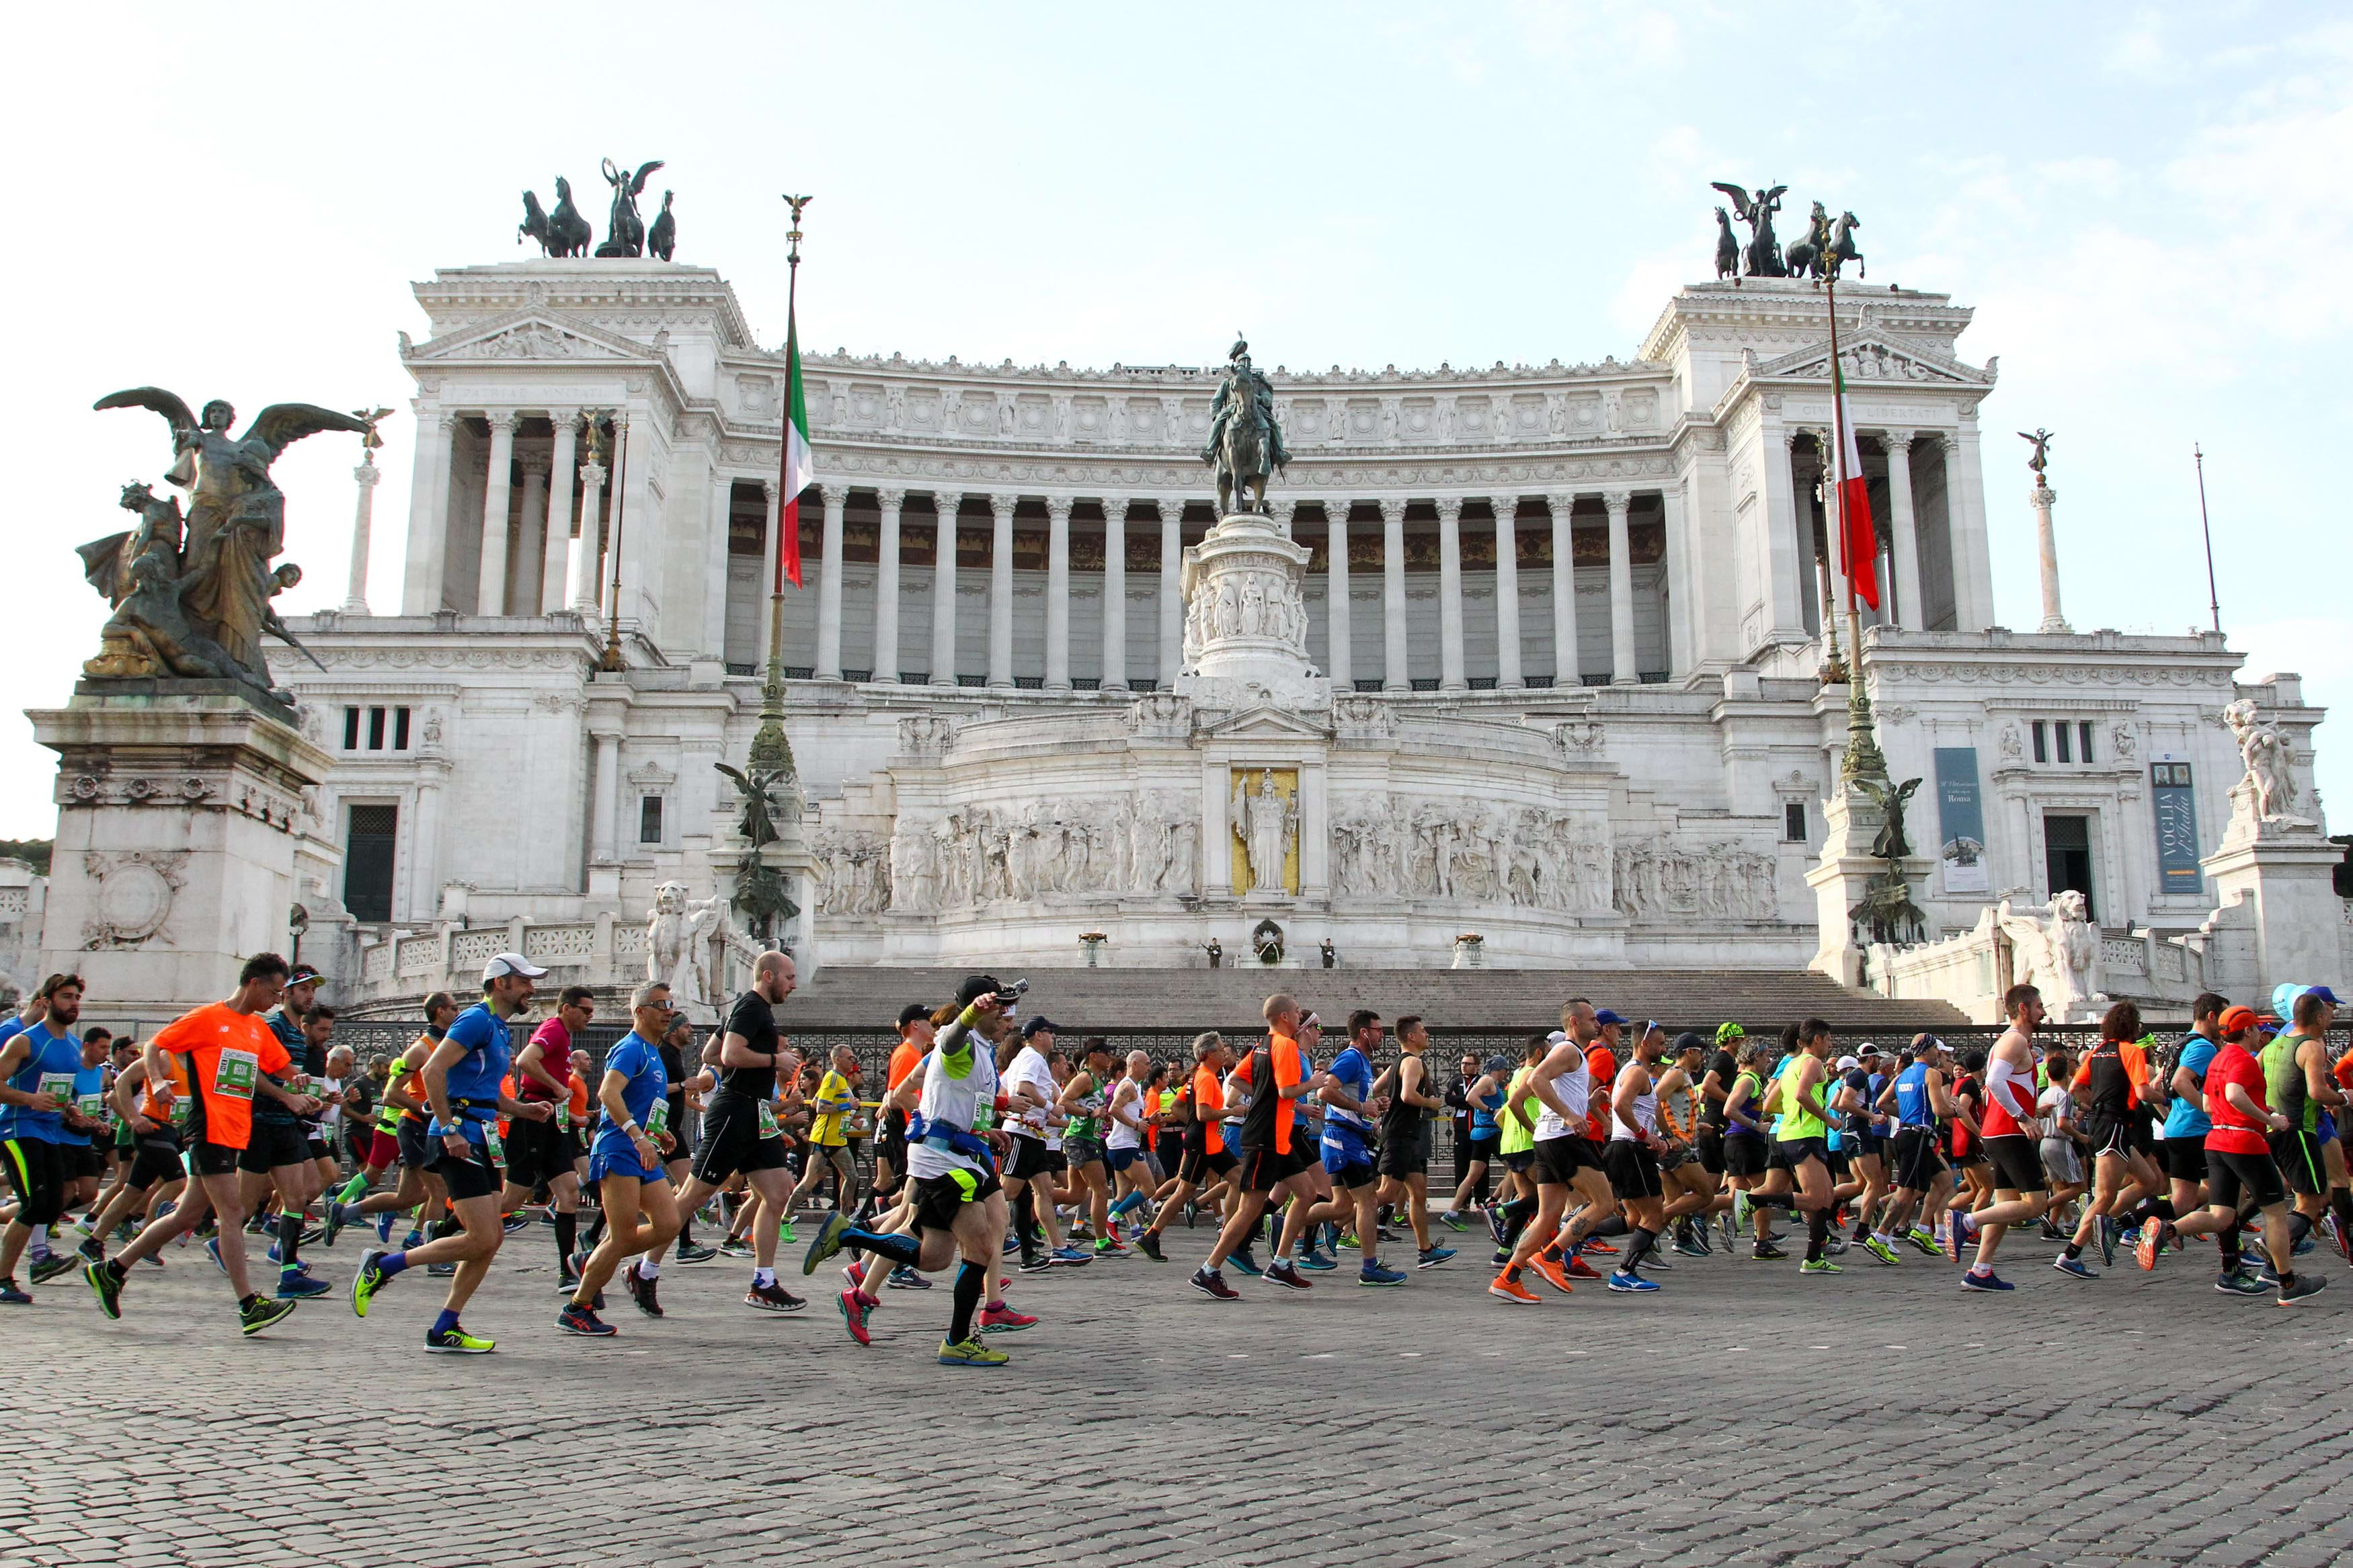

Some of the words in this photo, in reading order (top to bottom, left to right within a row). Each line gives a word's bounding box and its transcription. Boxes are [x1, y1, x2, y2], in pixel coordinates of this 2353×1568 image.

[1867, 408, 1936, 419] LIBERTATI
[1948, 794, 1971, 802] Roma
[2159, 793, 2176, 857] VOGLIA
[1898, 1083, 1914, 1092] ROCKY
